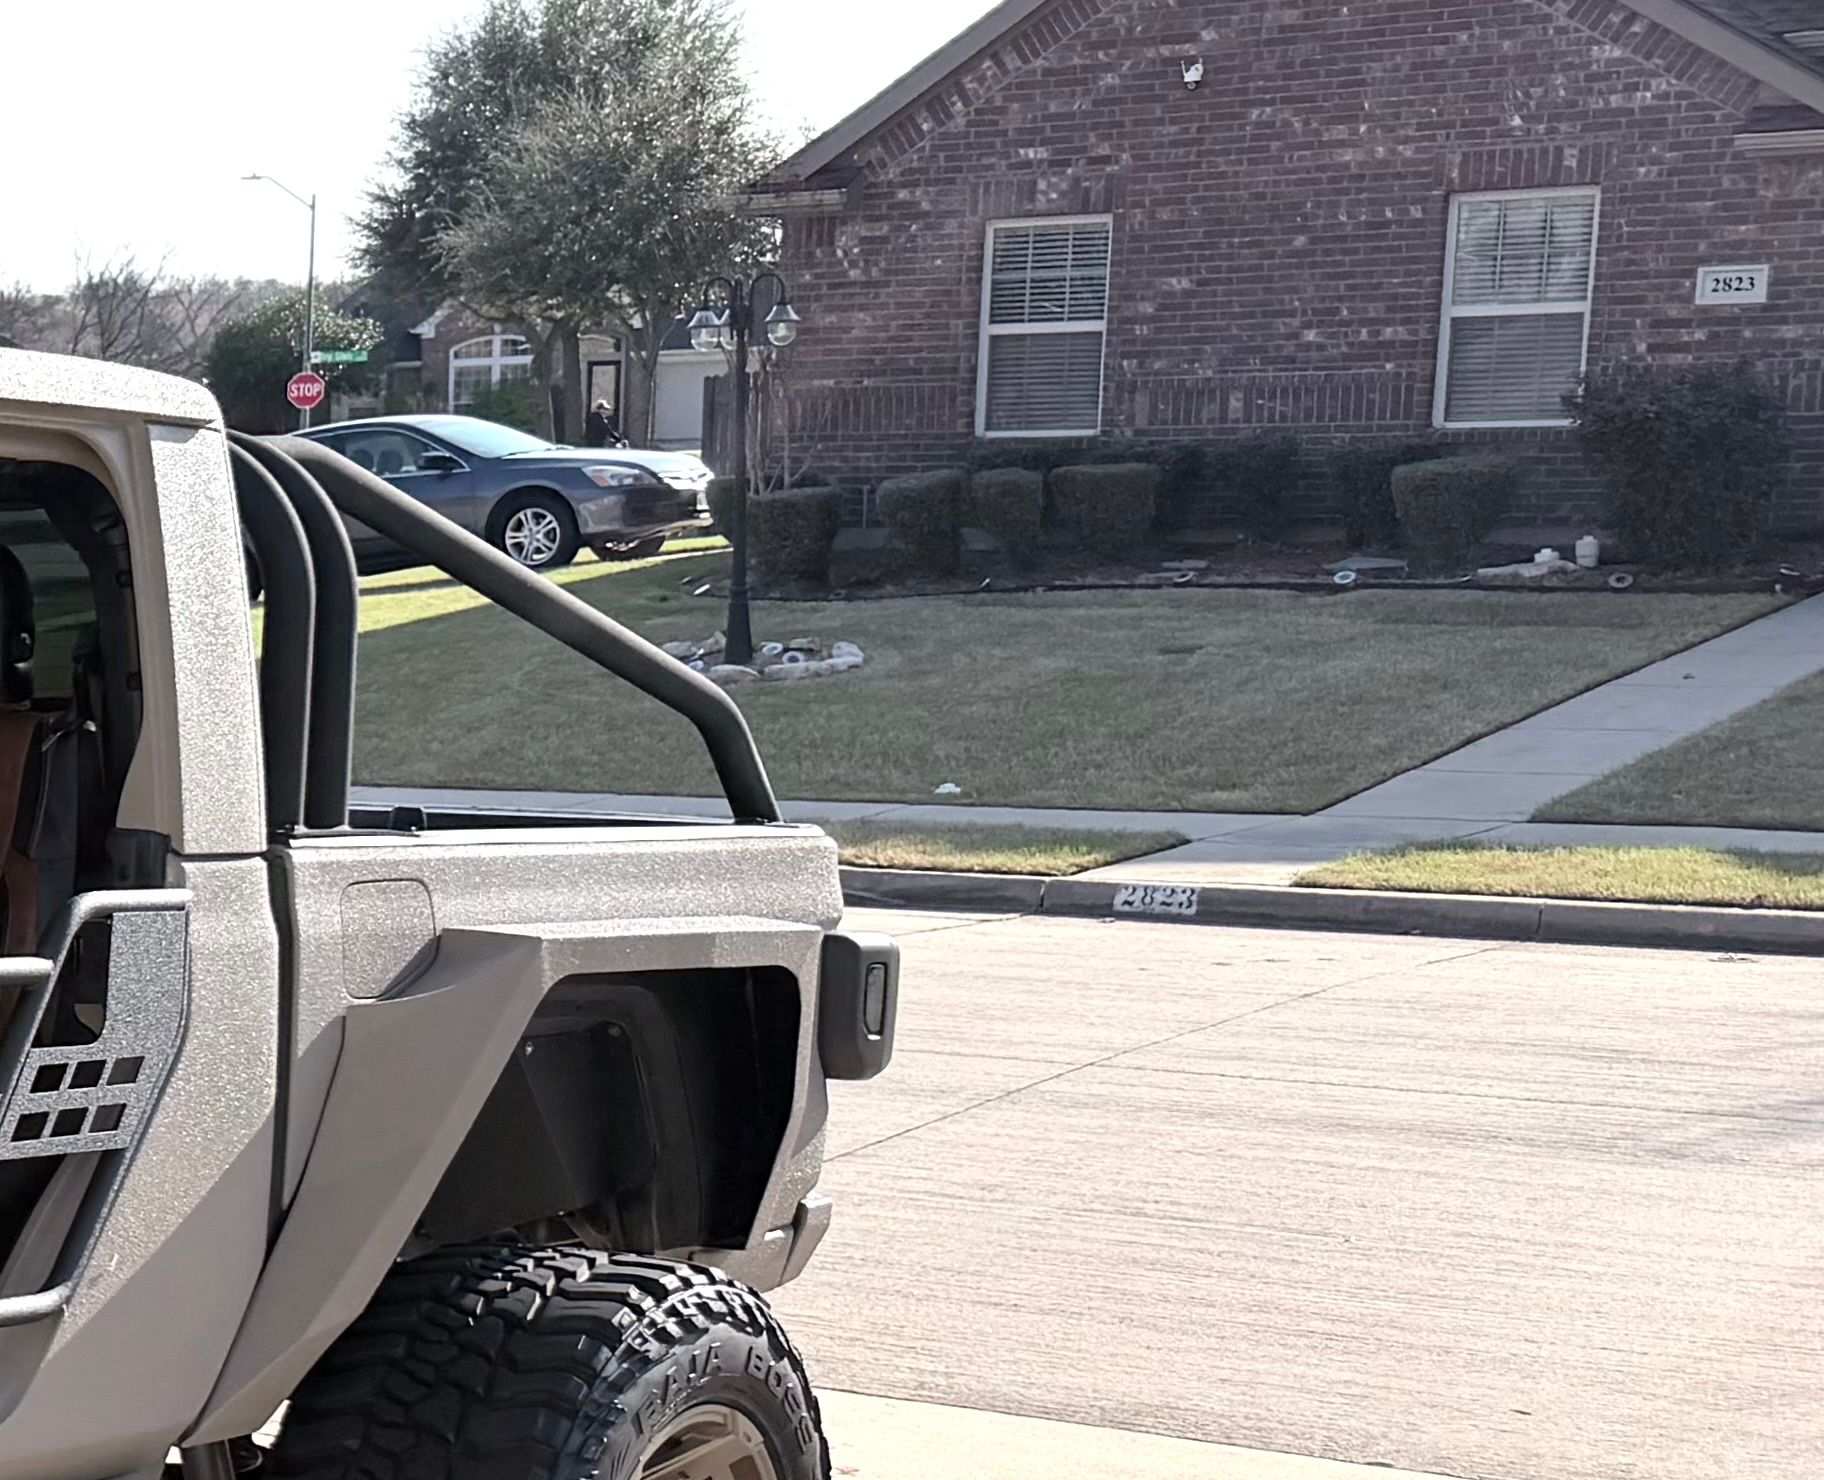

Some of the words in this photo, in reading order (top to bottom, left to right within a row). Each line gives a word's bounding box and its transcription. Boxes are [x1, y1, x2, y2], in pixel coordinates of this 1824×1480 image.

[1711, 276, 1755, 292] 2823
[290, 383, 322, 397] STOP
[1121, 885, 1196, 909] 2823
[746, 1346, 813, 1454] BOSS
